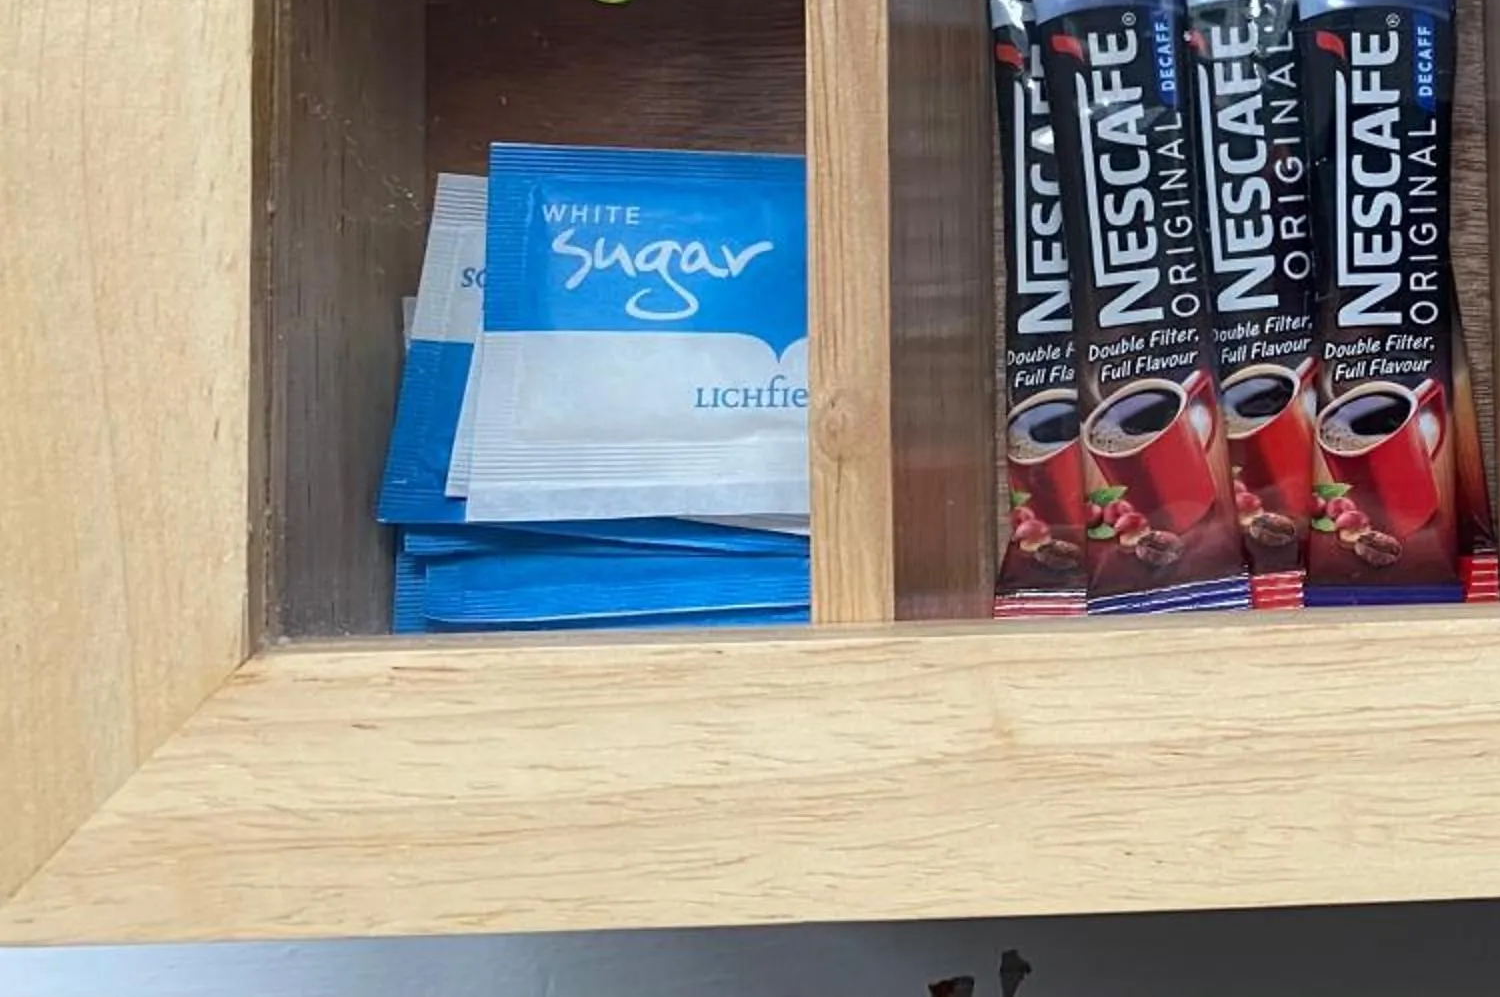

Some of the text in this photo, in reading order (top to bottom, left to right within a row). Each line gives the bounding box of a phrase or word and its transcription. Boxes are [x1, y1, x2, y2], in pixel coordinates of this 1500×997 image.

[1154, 22, 1176, 92] DECAFF
[1417, 25, 1434, 97] DECAFF
[1266, 30, 1311, 281] ORIGINAL
[542, 202, 640, 225] WHITE
[1154, 112, 1200, 318] ORIGINAL
[1407, 118, 1439, 325] ORIGINAL
[1089, 335, 1145, 362] Double
[1221, 337, 1312, 364] Full Flavour
[1324, 339, 1381, 360] Double
[1015, 368, 1046, 388] Full
[1101, 363, 1132, 383] Full
[1136, 351, 1199, 374] Flavour
[1335, 357, 1432, 381] Full Flavour
